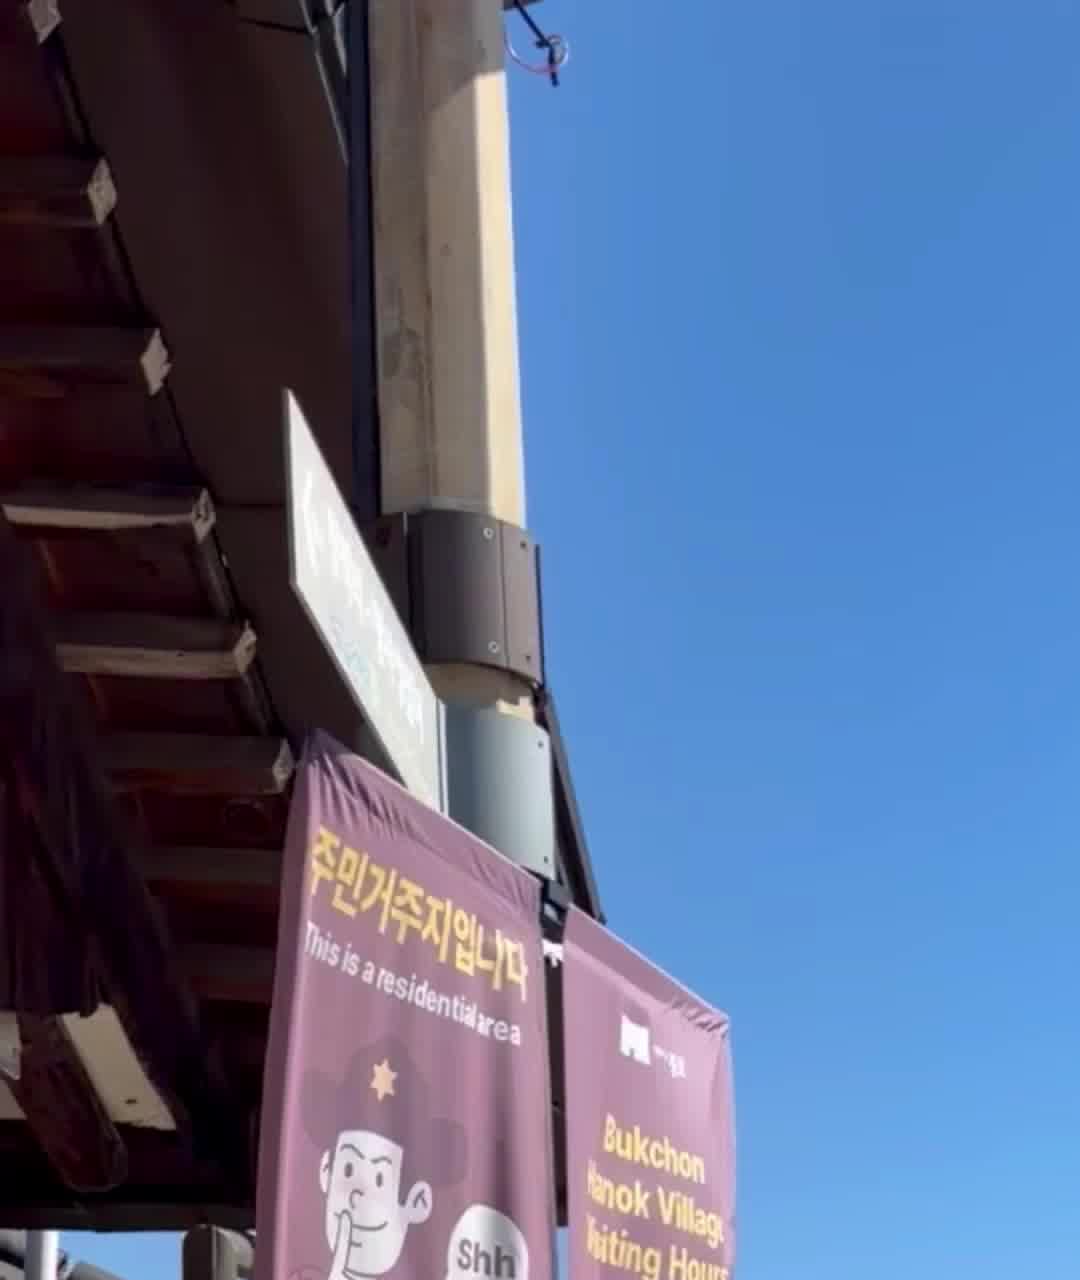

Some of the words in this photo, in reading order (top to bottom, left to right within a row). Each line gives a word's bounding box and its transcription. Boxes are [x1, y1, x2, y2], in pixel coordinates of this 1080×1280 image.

[311, 825, 528, 1003] 주민거주지입니다
[304, 920, 341, 967] This
[342, 943, 360, 976] is
[361, 961, 375, 984] a
[376, 968, 477, 1030] residential
[477, 1013, 521, 1045] area
[604, 1112, 706, 1184] Bukchon
[657, 1185, 725, 1249] Villag
[457, 1237, 516, 1280] Shh
